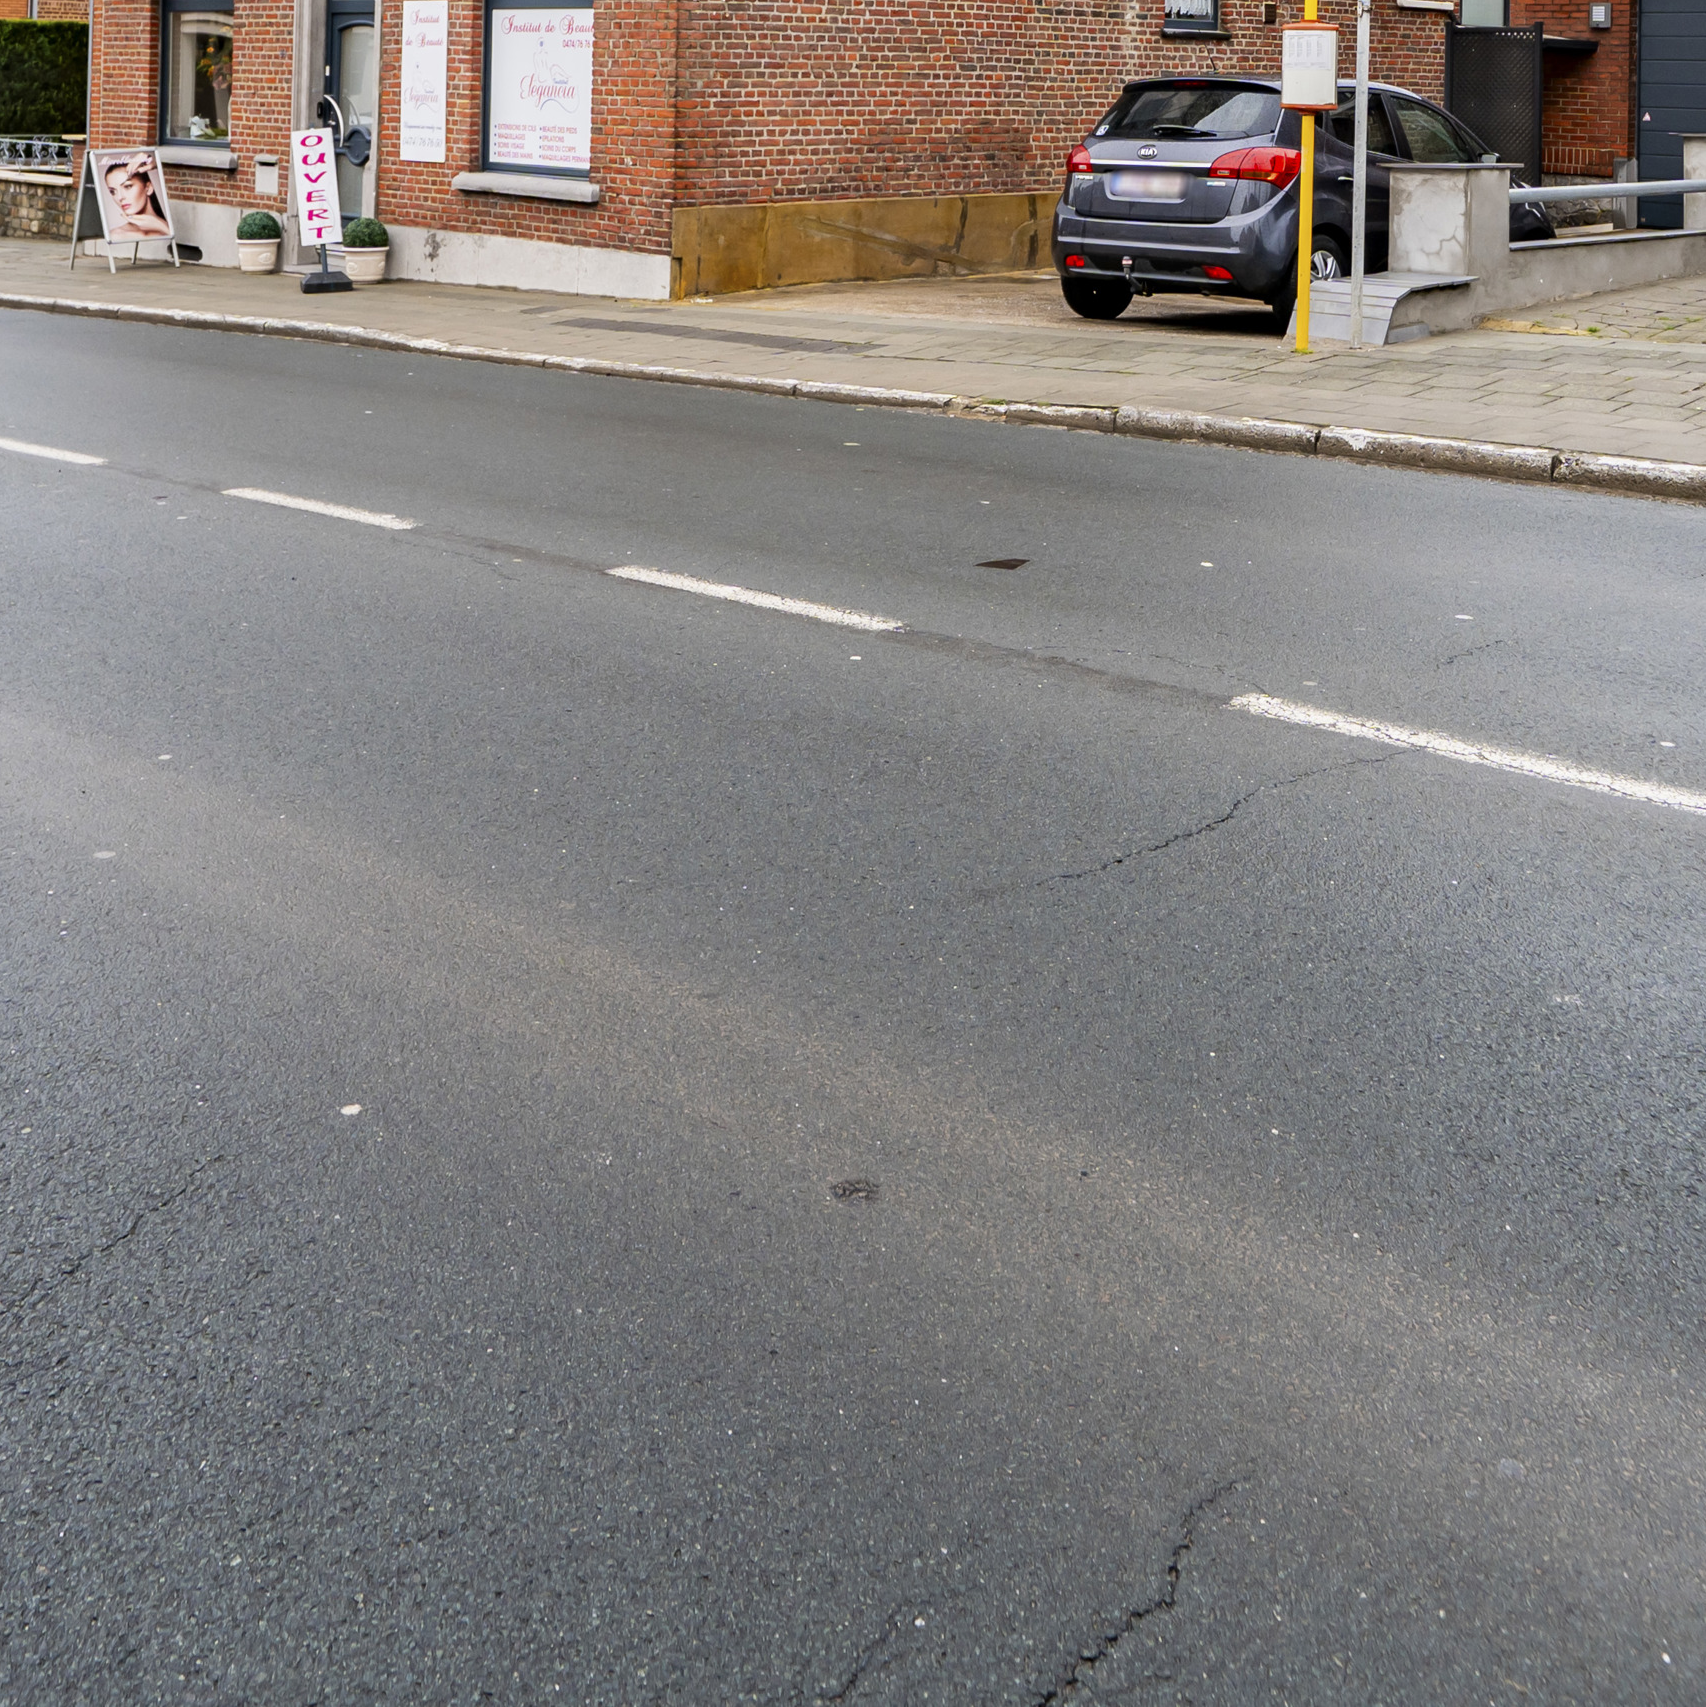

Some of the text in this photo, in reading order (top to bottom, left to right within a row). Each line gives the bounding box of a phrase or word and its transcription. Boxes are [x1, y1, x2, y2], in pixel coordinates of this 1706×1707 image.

[410, 9, 440, 25] Institut
[501, 14, 594, 35] Institut de Beaut
[405, 35, 413, 46] de
[520, 73, 576, 108] Elegancia
[1140, 148, 1154, 156] KIA
[299, 134, 334, 239] OUVERT
